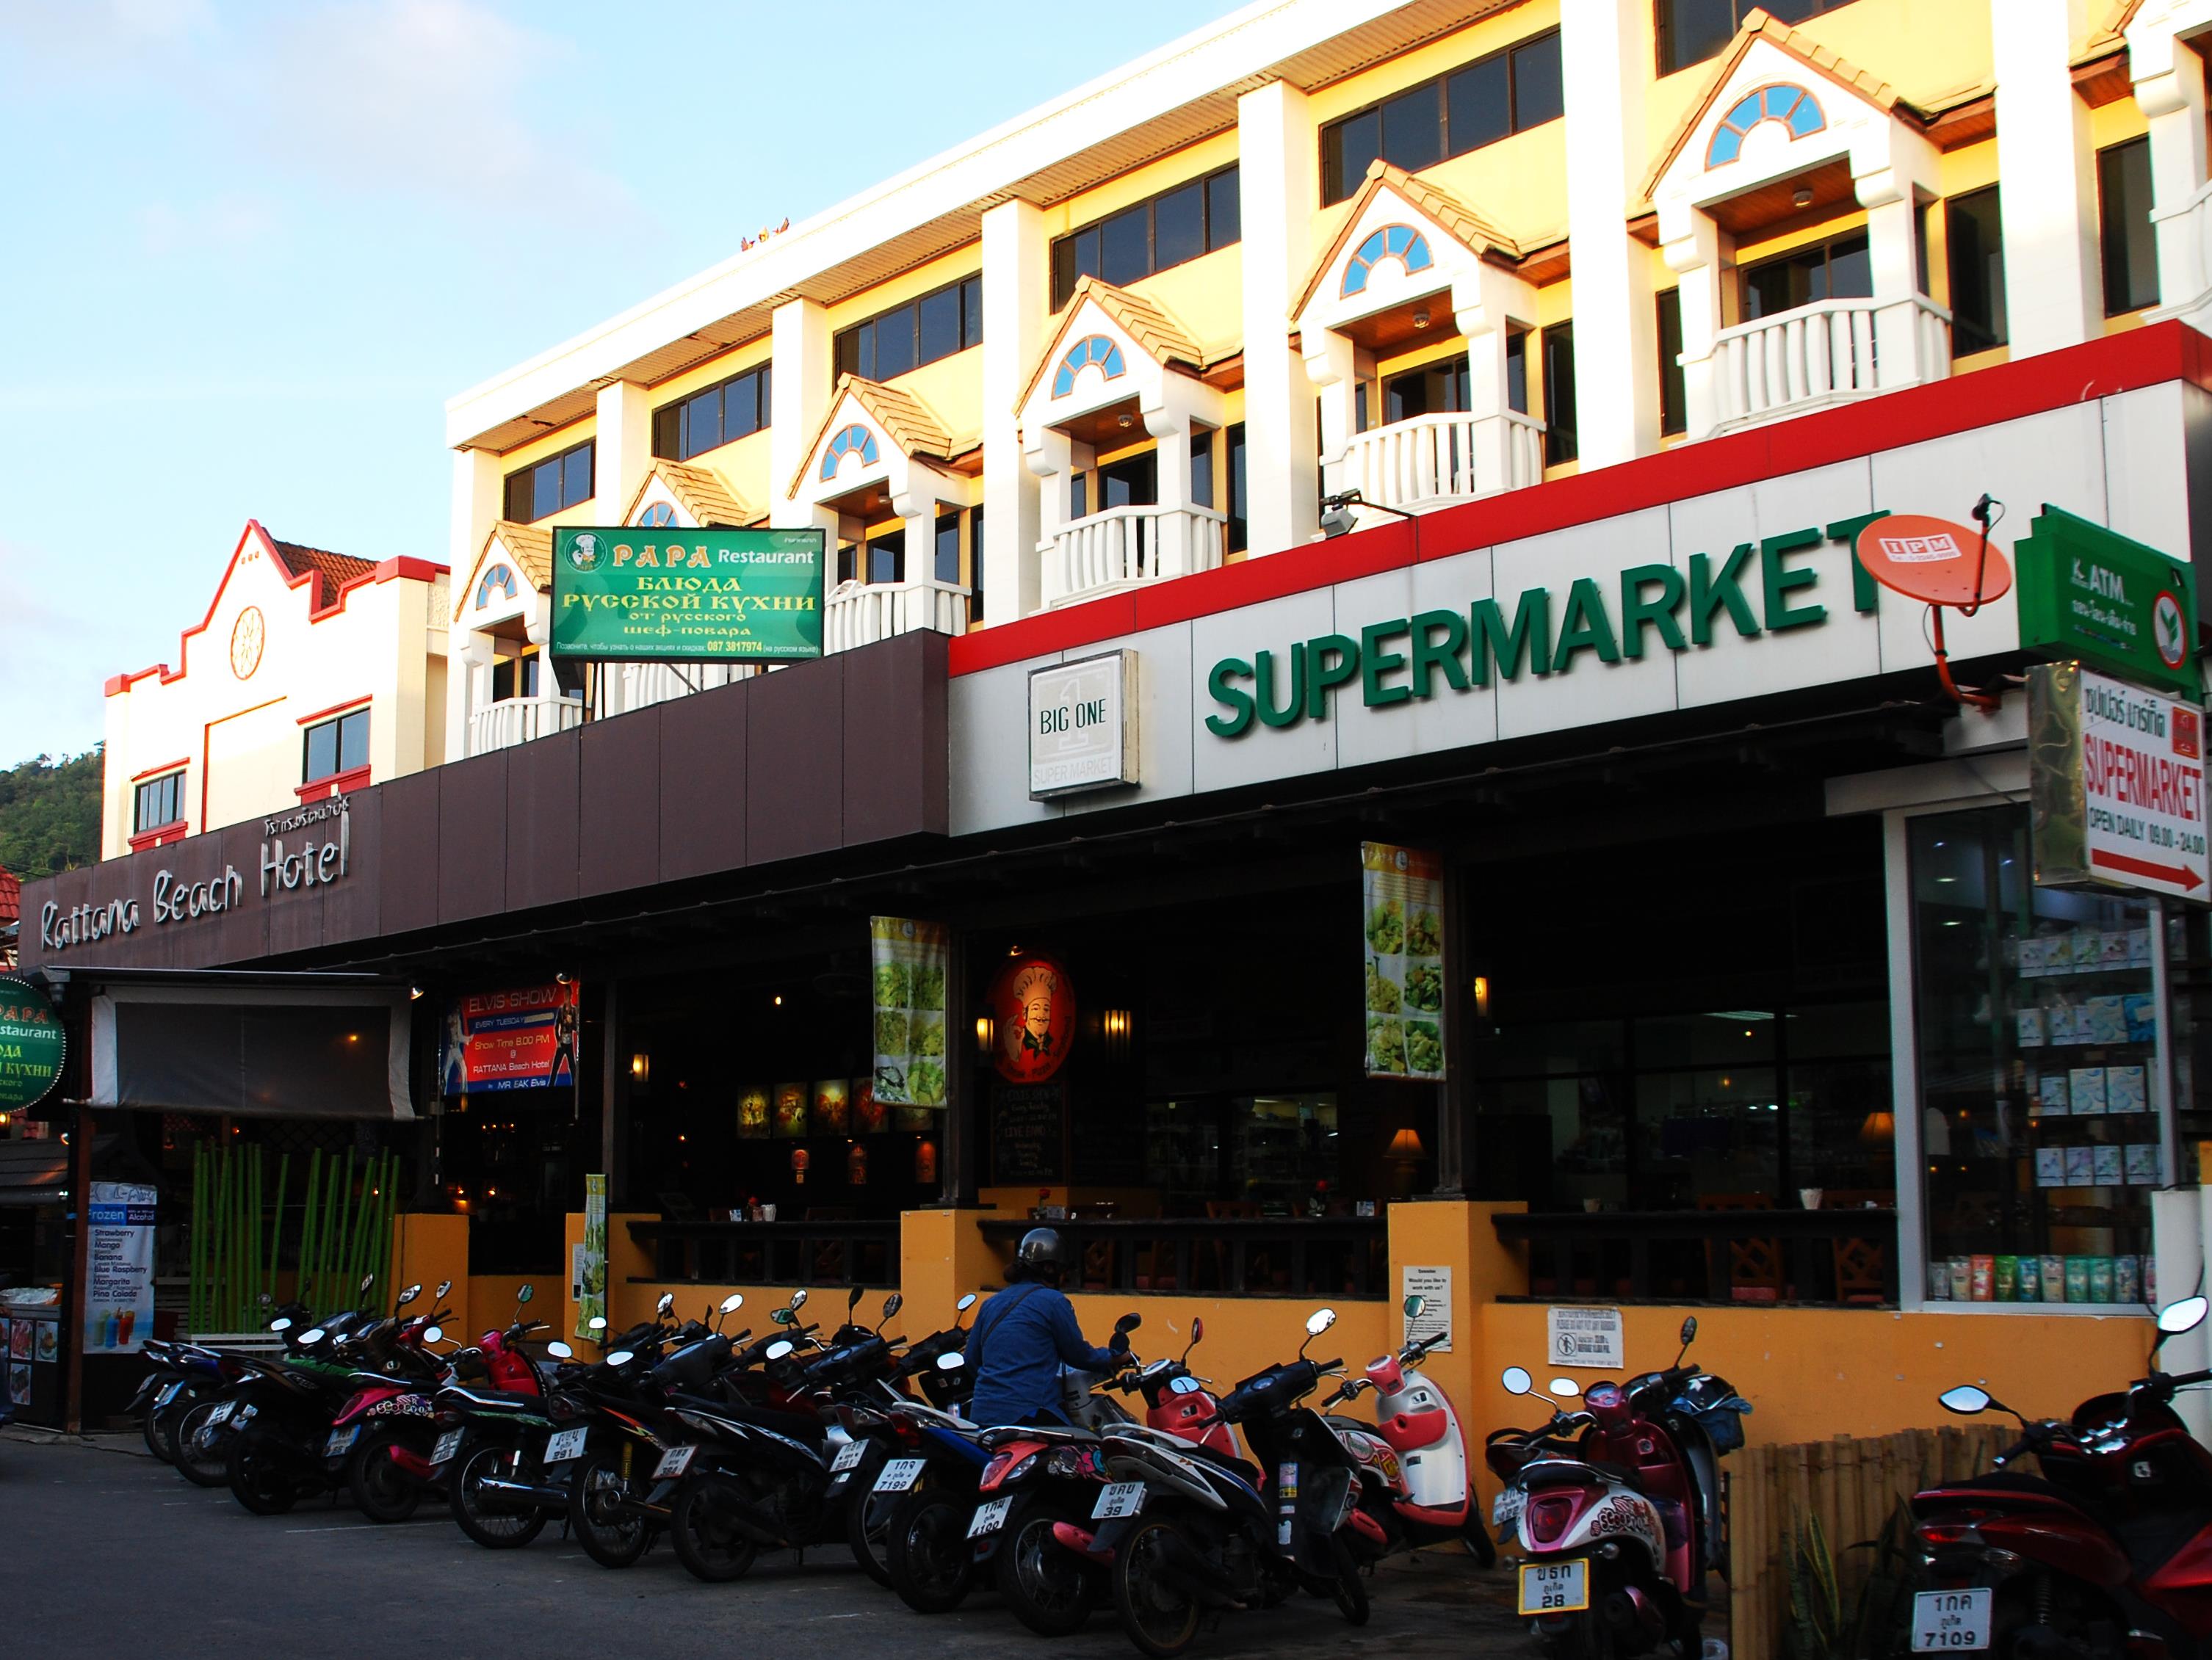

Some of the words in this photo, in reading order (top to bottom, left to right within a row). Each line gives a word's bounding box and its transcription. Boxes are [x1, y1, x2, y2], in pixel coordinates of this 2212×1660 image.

[1884, 536, 1951, 554] IPM
[612, 544, 712, 568] PAPA
[718, 548, 814, 565] Restaurant
[635, 577, 742, 593] БЛЮДА
[561, 592, 702, 612] РУССКОЙ
[710, 595, 816, 614] КУХНИ
[1204, 510, 1893, 739] SUPERMARKET
[706, 641, 723, 652] 087
[726, 641, 762, 652] 3817974
[1041, 706, 1069, 735] BIG
[1075, 698, 1107, 728] ONE
[1033, 764, 1067, 786] SUPER
[1069, 755, 1113, 778] MARKET
[2084, 733, 2202, 822] SUPERMARKET
[2090, 807, 2115, 834] OPEN
[2117, 813, 2145, 841] DAILY
[42, 899, 141, 952] Rattana
[153, 864, 244, 924] Beach
[261, 811, 350, 897] Hotel
[469, 994, 505, 1013] ELVIS
[510, 987, 557, 1008] SHOW
[475, 1020, 494, 1029] EVERY
[496, 1016, 524, 1026] TUESDAY
[475, 1041, 494, 1051] Show
[496, 1039, 514, 1051] Time
[535, 1034, 550, 1044] PM
[473, 1064, 507, 1073] RATTANA
[509, 1062, 529, 1071] Beach
[531, 1059, 550, 1068] Hotel
[129, 1213, 154, 1221] Alcohol
[95, 1229, 134, 1238] Strawberry
[94, 1242, 120, 1250] Mango
[112, 1266, 147, 1274] Raspberry
[93, 1278, 130, 1287] Margarita
[879, 1481, 907, 1490] 7199
[1103, 1506, 1123, 1516] 39
[1542, 1594, 1565, 1608] 28
[1925, 1631, 1976, 1647] 7109
